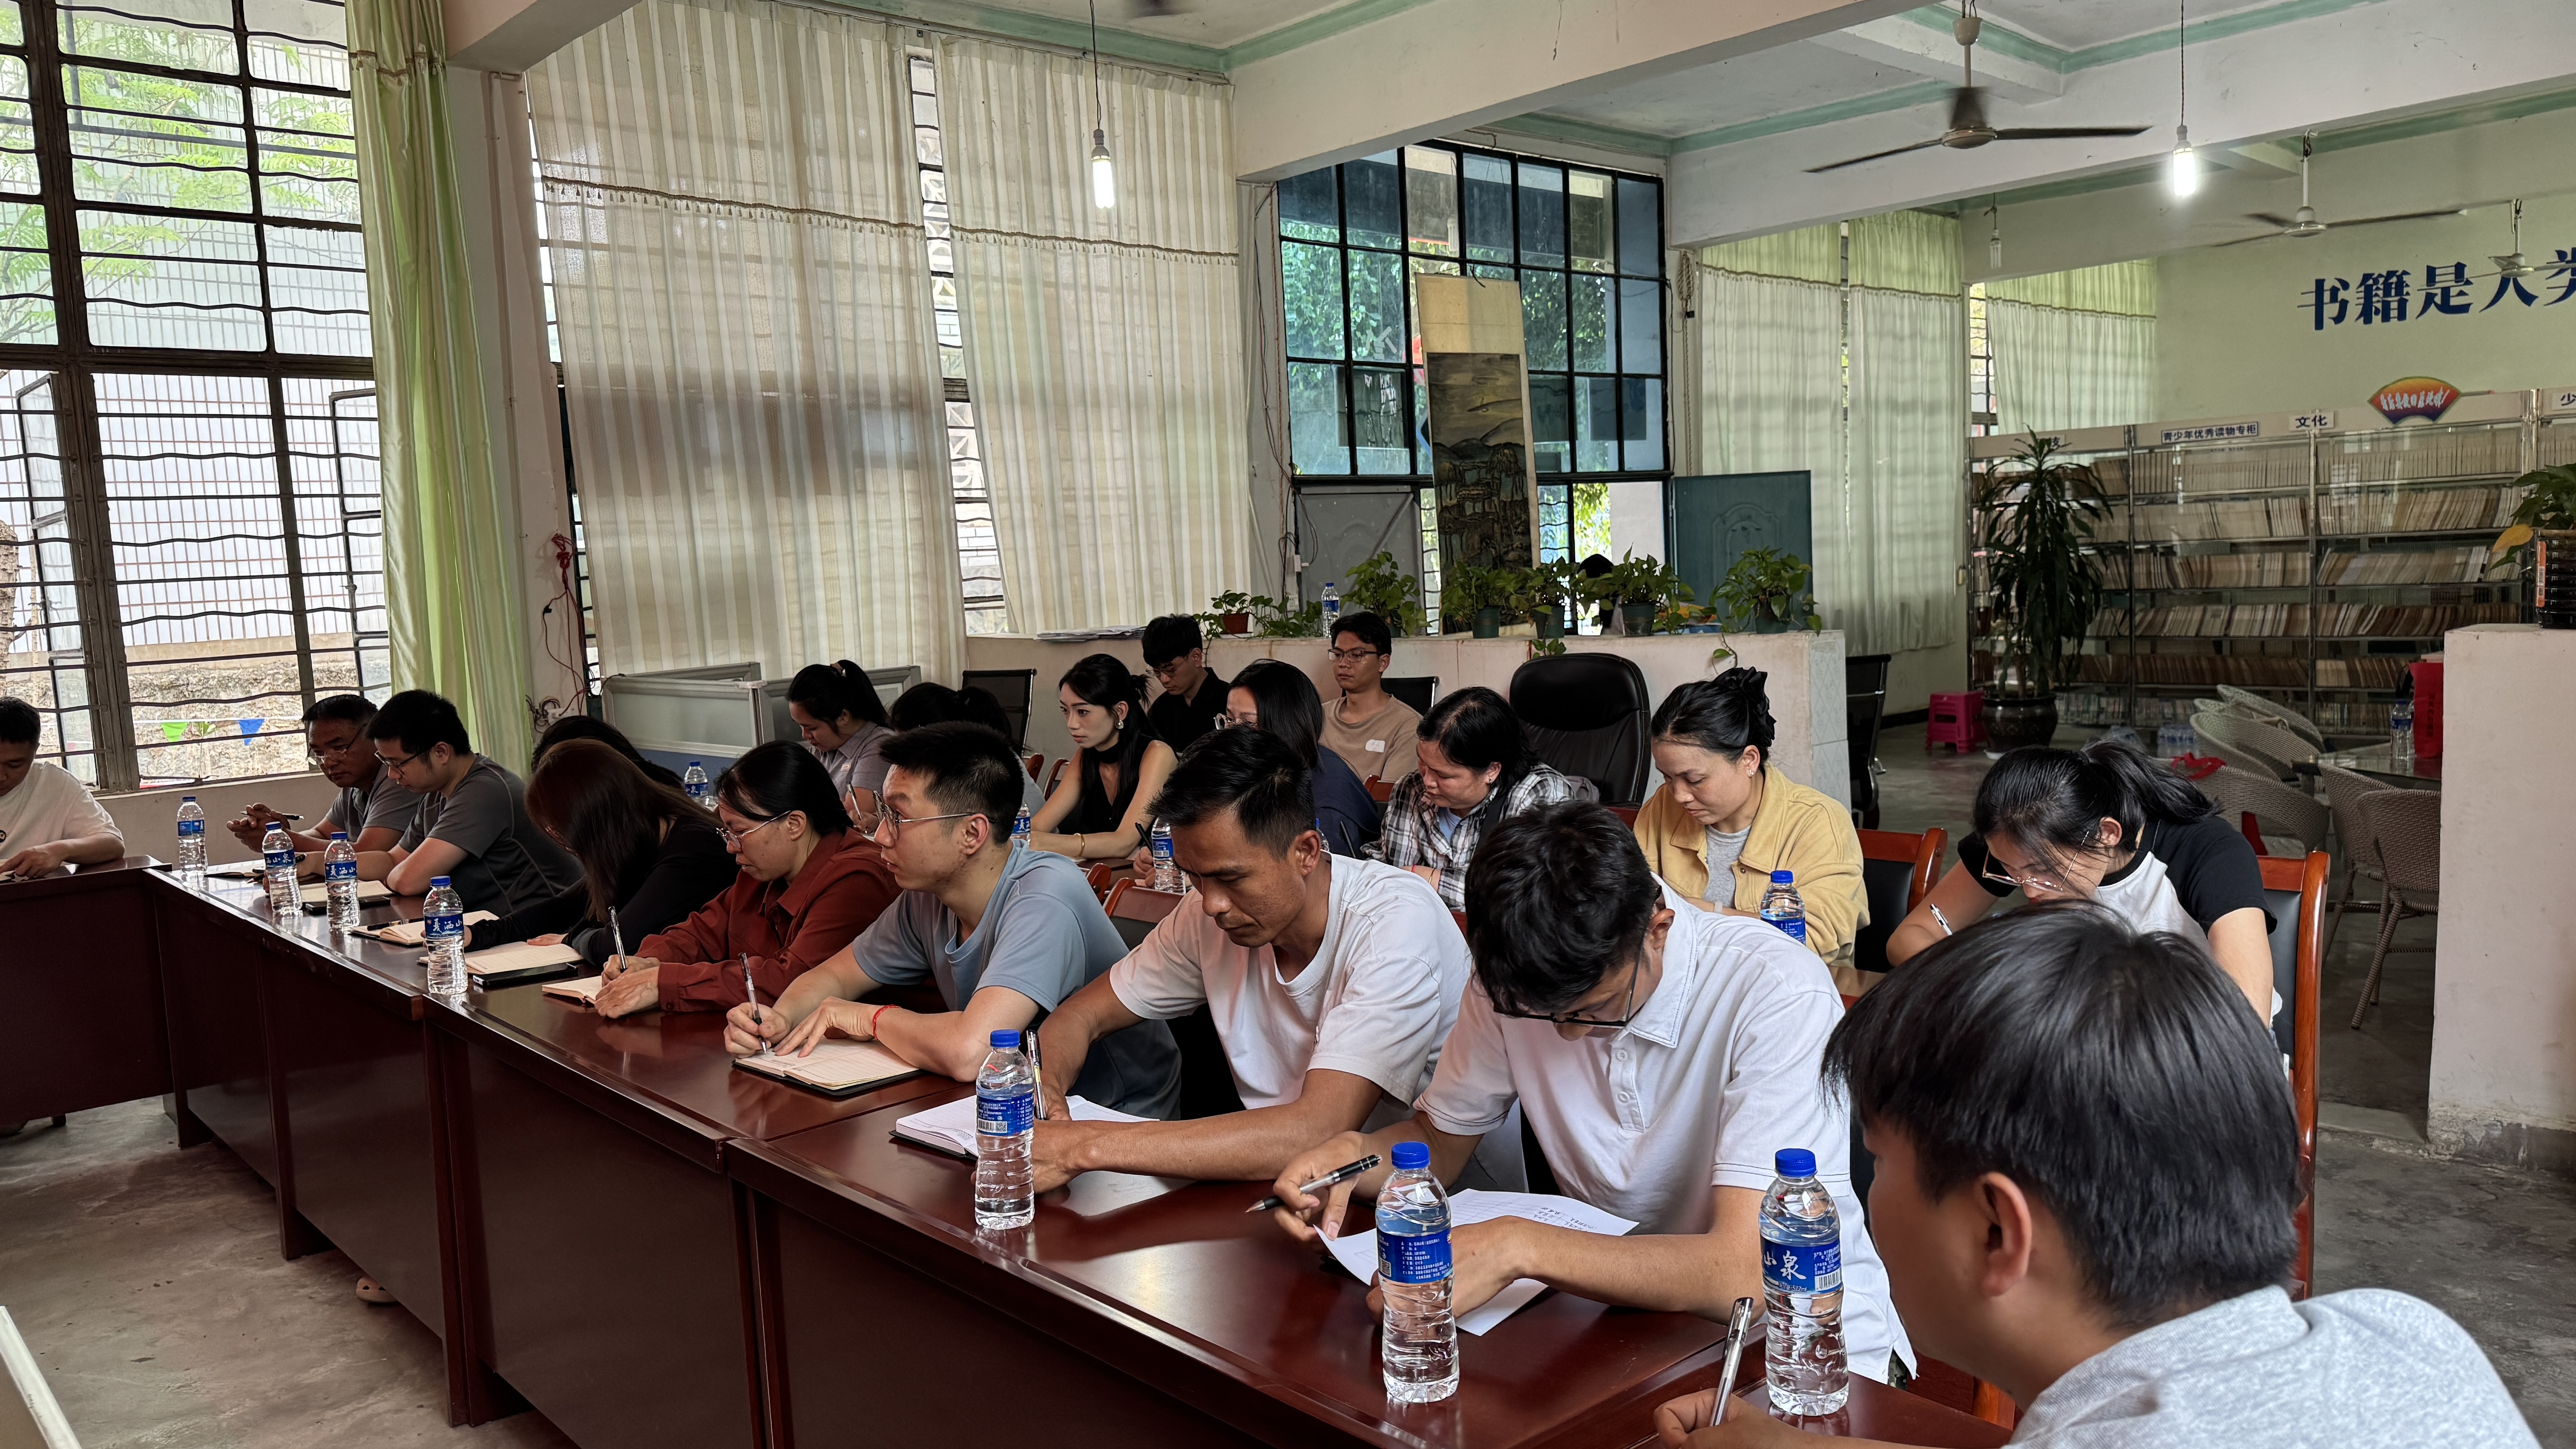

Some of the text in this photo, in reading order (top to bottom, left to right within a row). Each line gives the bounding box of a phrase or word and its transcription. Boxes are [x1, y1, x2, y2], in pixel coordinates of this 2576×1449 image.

[2295, 414, 2328, 428] 文化
[2164, 424, 2256, 441] 青少年优秀读物专柜
[1764, 1250, 1807, 1281] 山泉
